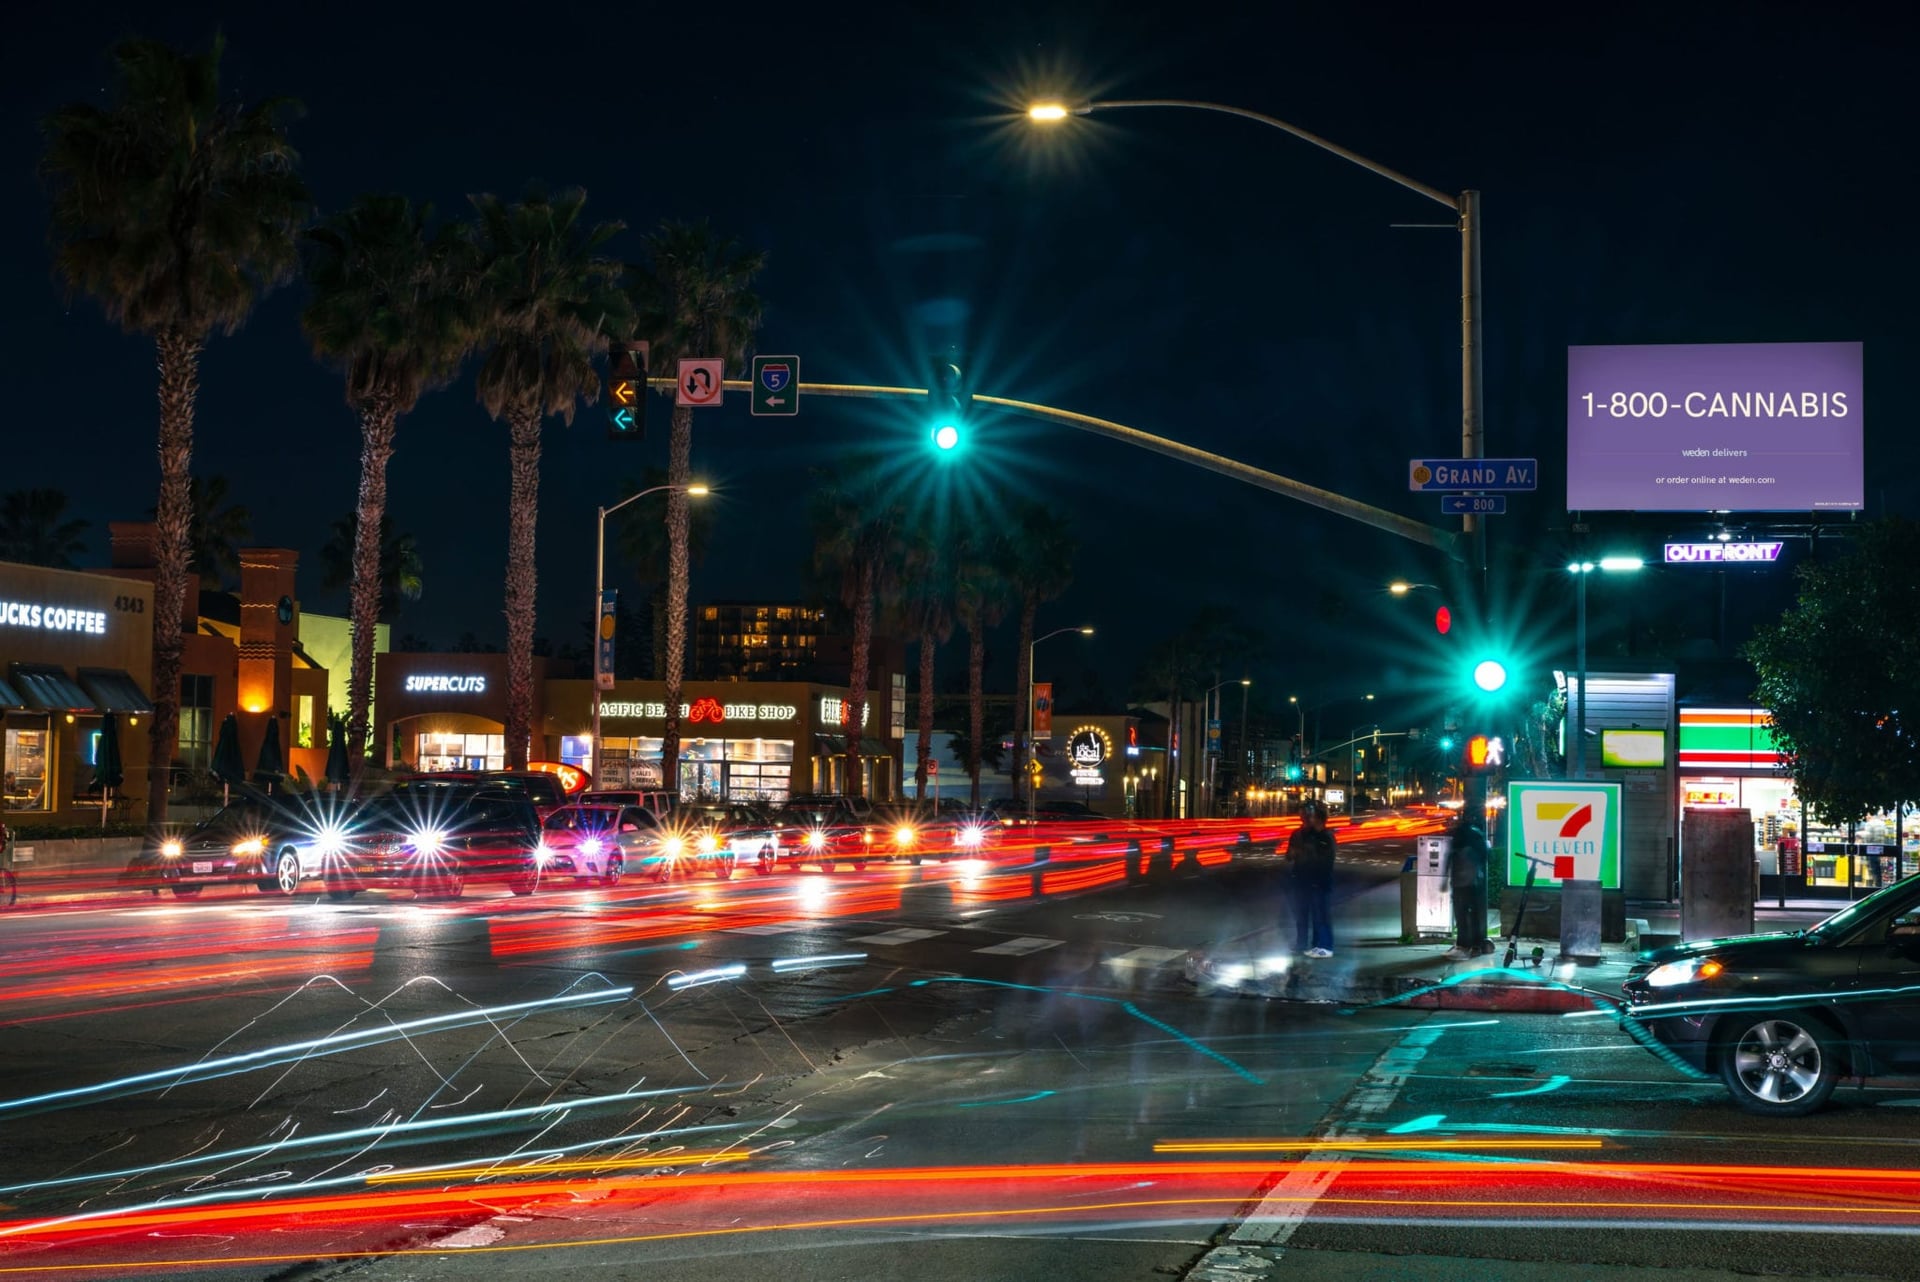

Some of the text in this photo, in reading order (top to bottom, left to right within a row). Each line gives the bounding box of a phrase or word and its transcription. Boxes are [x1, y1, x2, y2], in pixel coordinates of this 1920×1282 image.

[771, 374, 780, 388] 5
[1582, 391, 1848, 417] 1-800-CANNABIS
[1682, 448, 1748, 457] weden delivers
[1667, 475, 1689, 484] order
[1691, 475, 1716, 484] online
[1718, 476, 1726, 484] at
[1728, 475, 1775, 484] weden.com
[1473, 498, 1495, 511] 800
[1668, 544, 1777, 560] OUTFRONT
[114, 595, 145, 613] 4343
[43, 606, 106, 633] COFFEE
[405, 675, 485, 692] SUPERCUTS
[591, 702, 643, 718] ACIFIC
[725, 705, 756, 719] BIKE
[758, 706, 796, 720] SHOP
